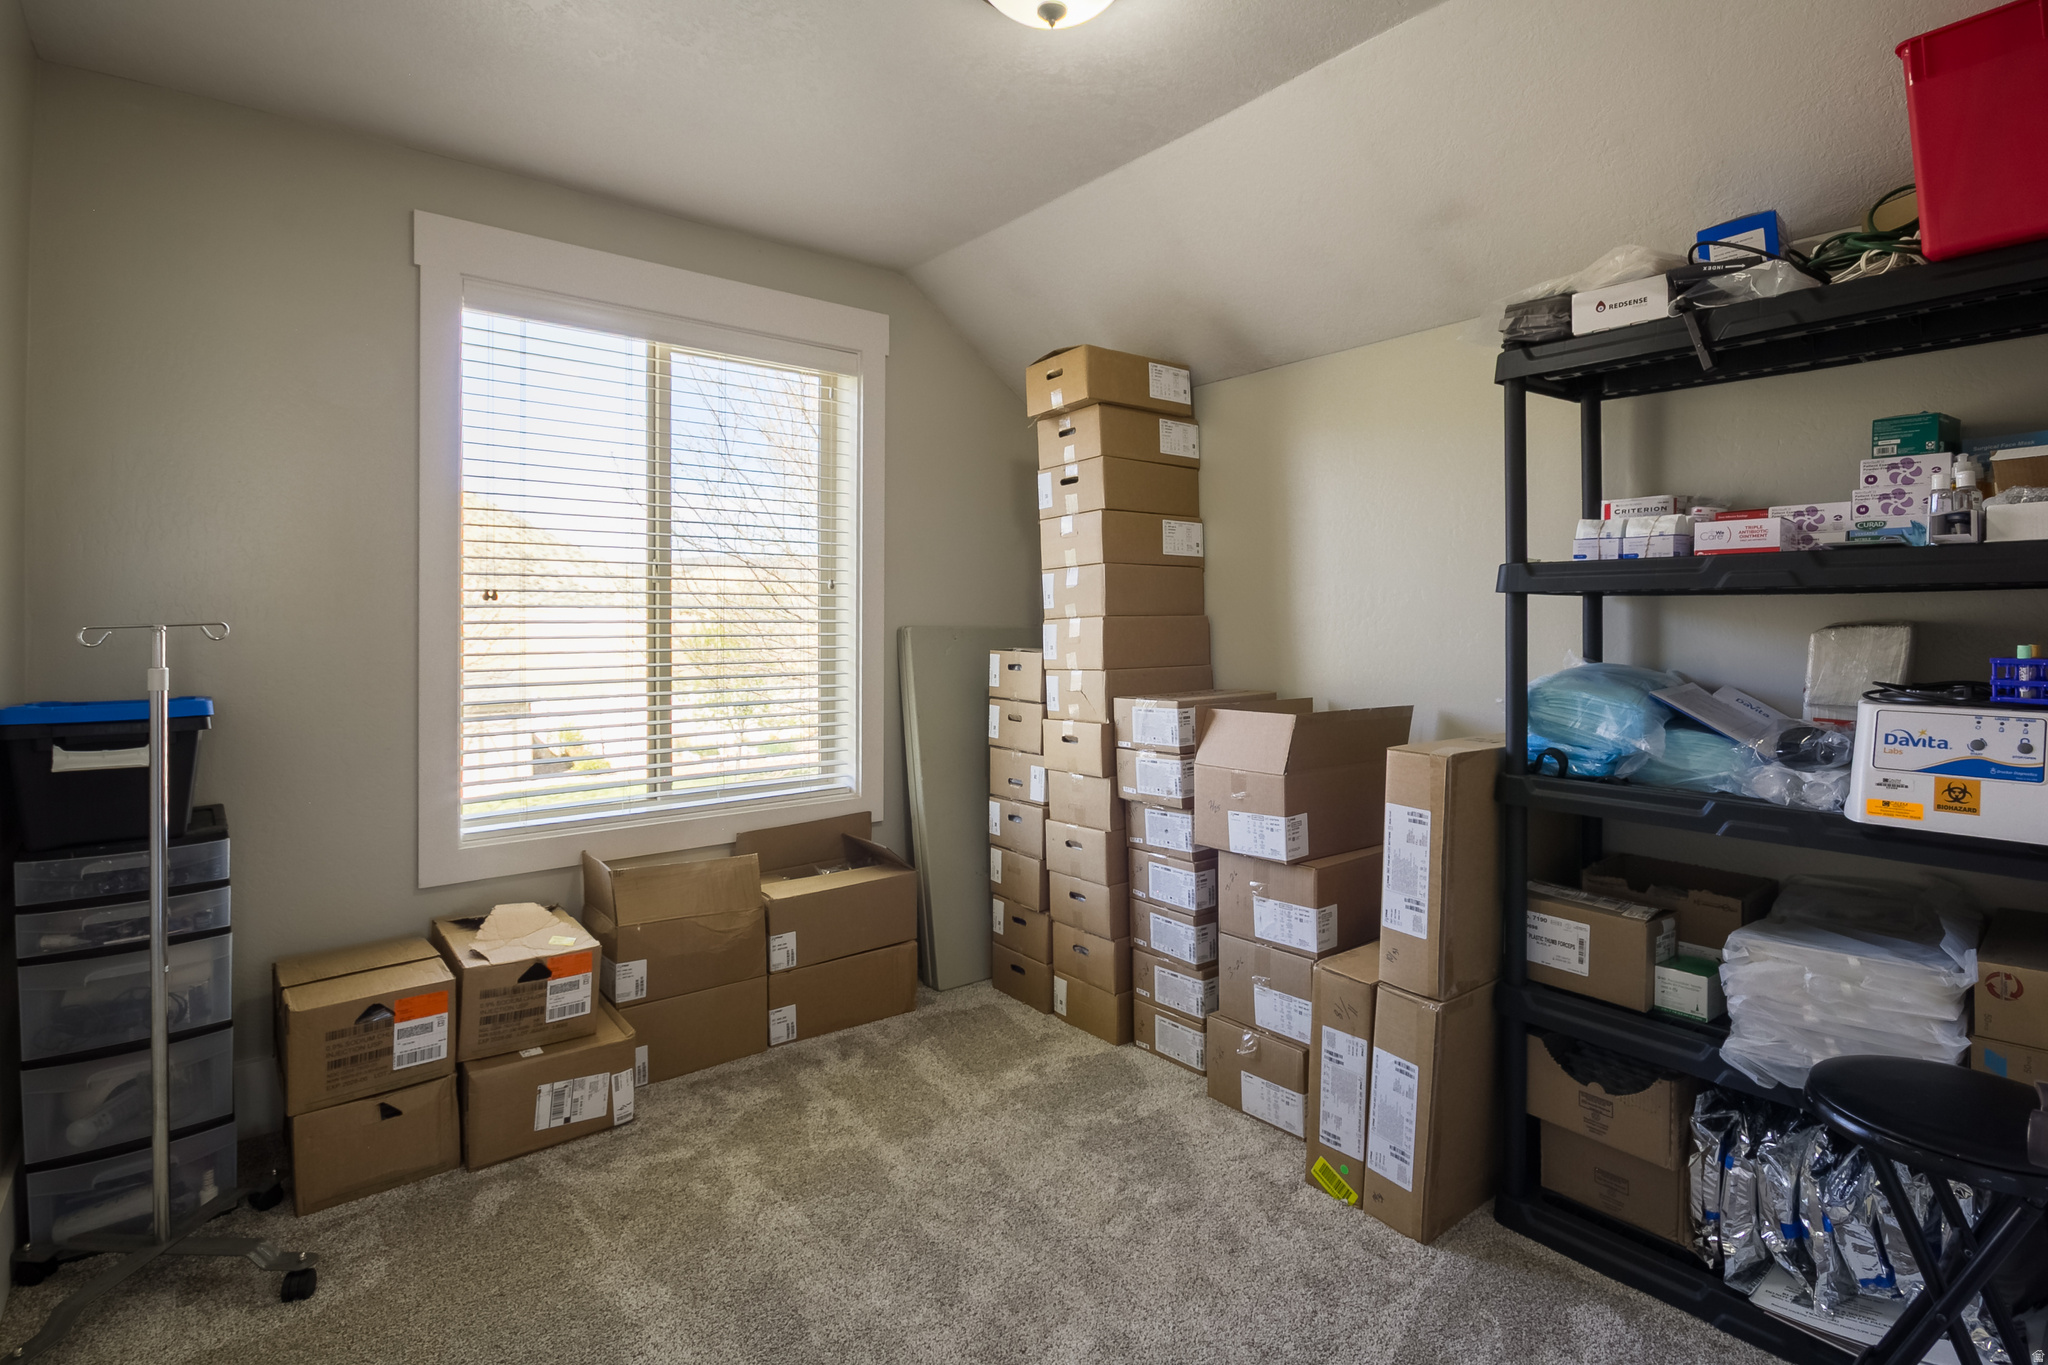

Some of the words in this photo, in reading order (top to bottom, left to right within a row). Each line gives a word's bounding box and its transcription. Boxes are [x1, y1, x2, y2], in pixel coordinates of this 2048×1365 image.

[1609, 296, 1648, 310] REDSENSE
[1614, 505, 1668, 515] CRITERION
[1700, 532, 1724, 541] Care
[1736, 697, 1769, 718] DaVita
[1884, 730, 1949, 750] DaVita
[1883, 747, 1904, 755] Labs
[1936, 804, 1977, 814] BIOHAZARD
[1532, 915, 1548, 923] 7190
[1528, 933, 1544, 942] PLASTIC
[1544, 937, 1557, 946] THUMB
[1557, 940, 1576, 950] FORCEPS
[345, 1034, 375, 1047] SODIUM
[325, 1044, 366, 1059] INJECTION
[367, 1040, 383, 1049] USP
